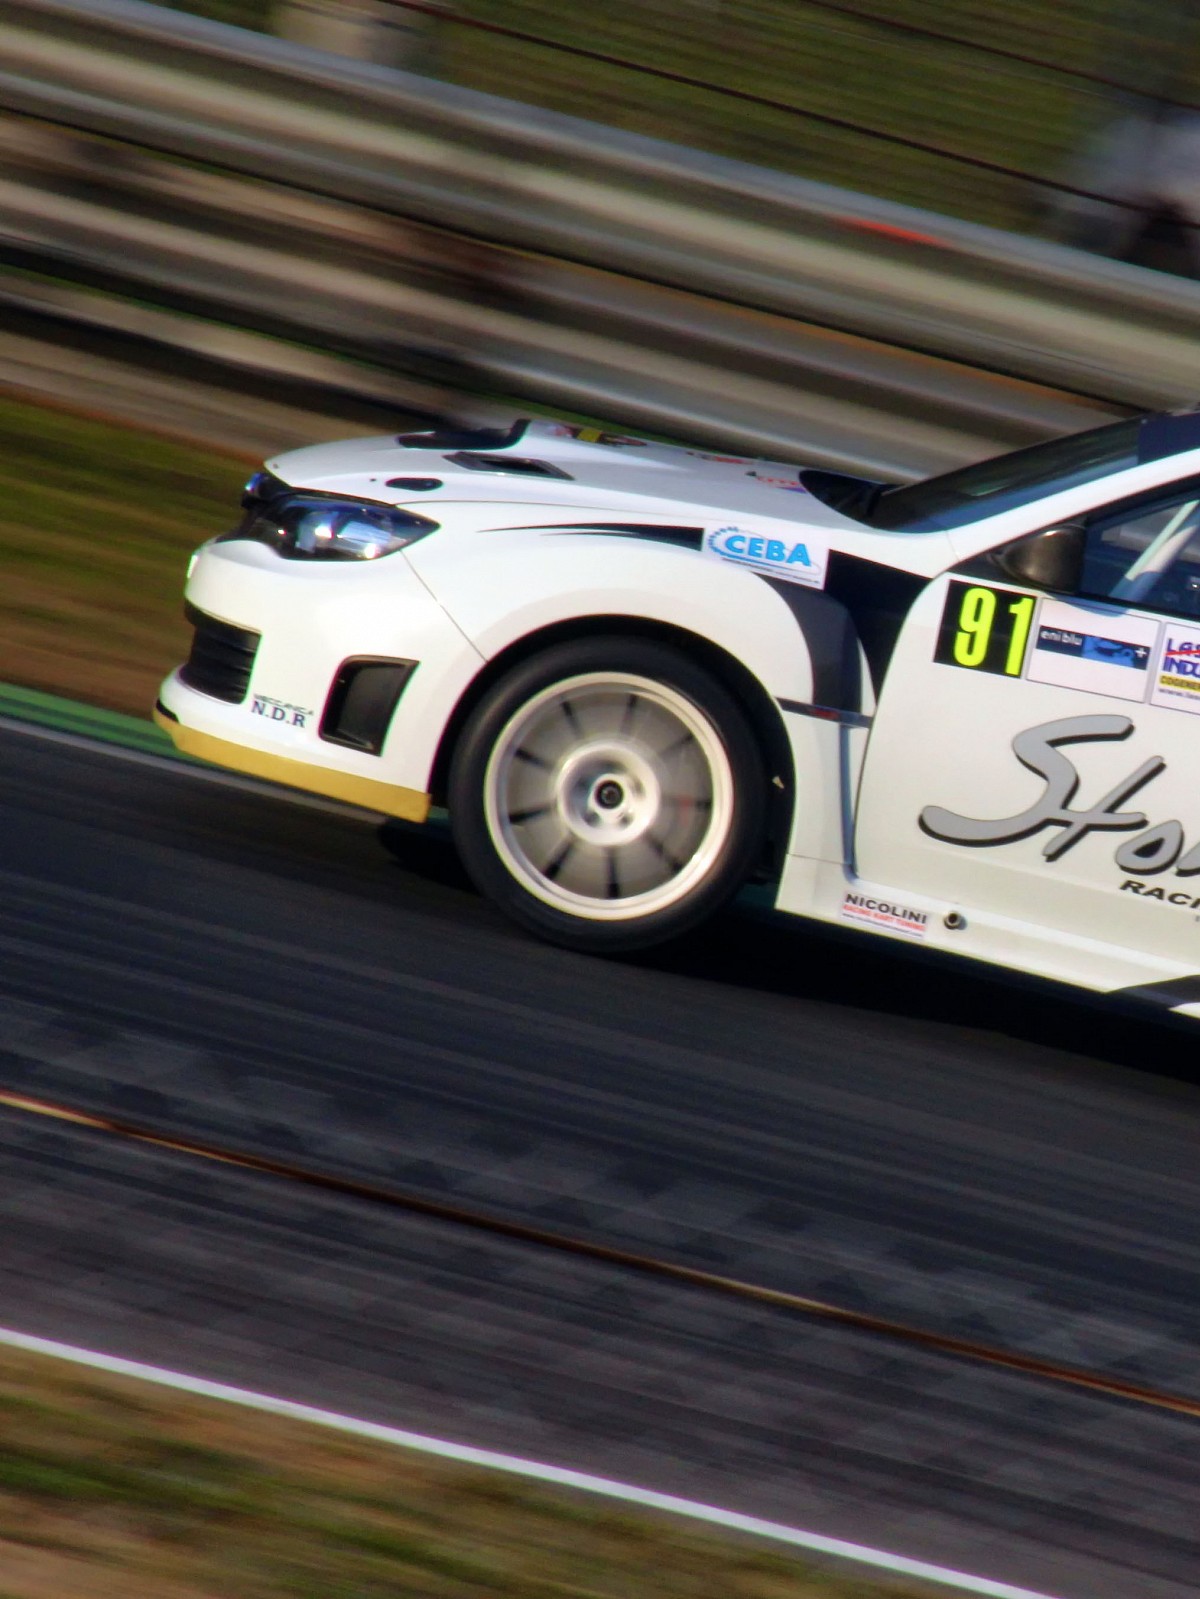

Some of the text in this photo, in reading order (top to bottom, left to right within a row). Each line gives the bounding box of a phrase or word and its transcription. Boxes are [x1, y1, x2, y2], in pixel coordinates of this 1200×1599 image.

[724, 534, 812, 567] CEBA
[953, 586, 1037, 677] 91
[846, 893, 929, 924] NICOLINI
